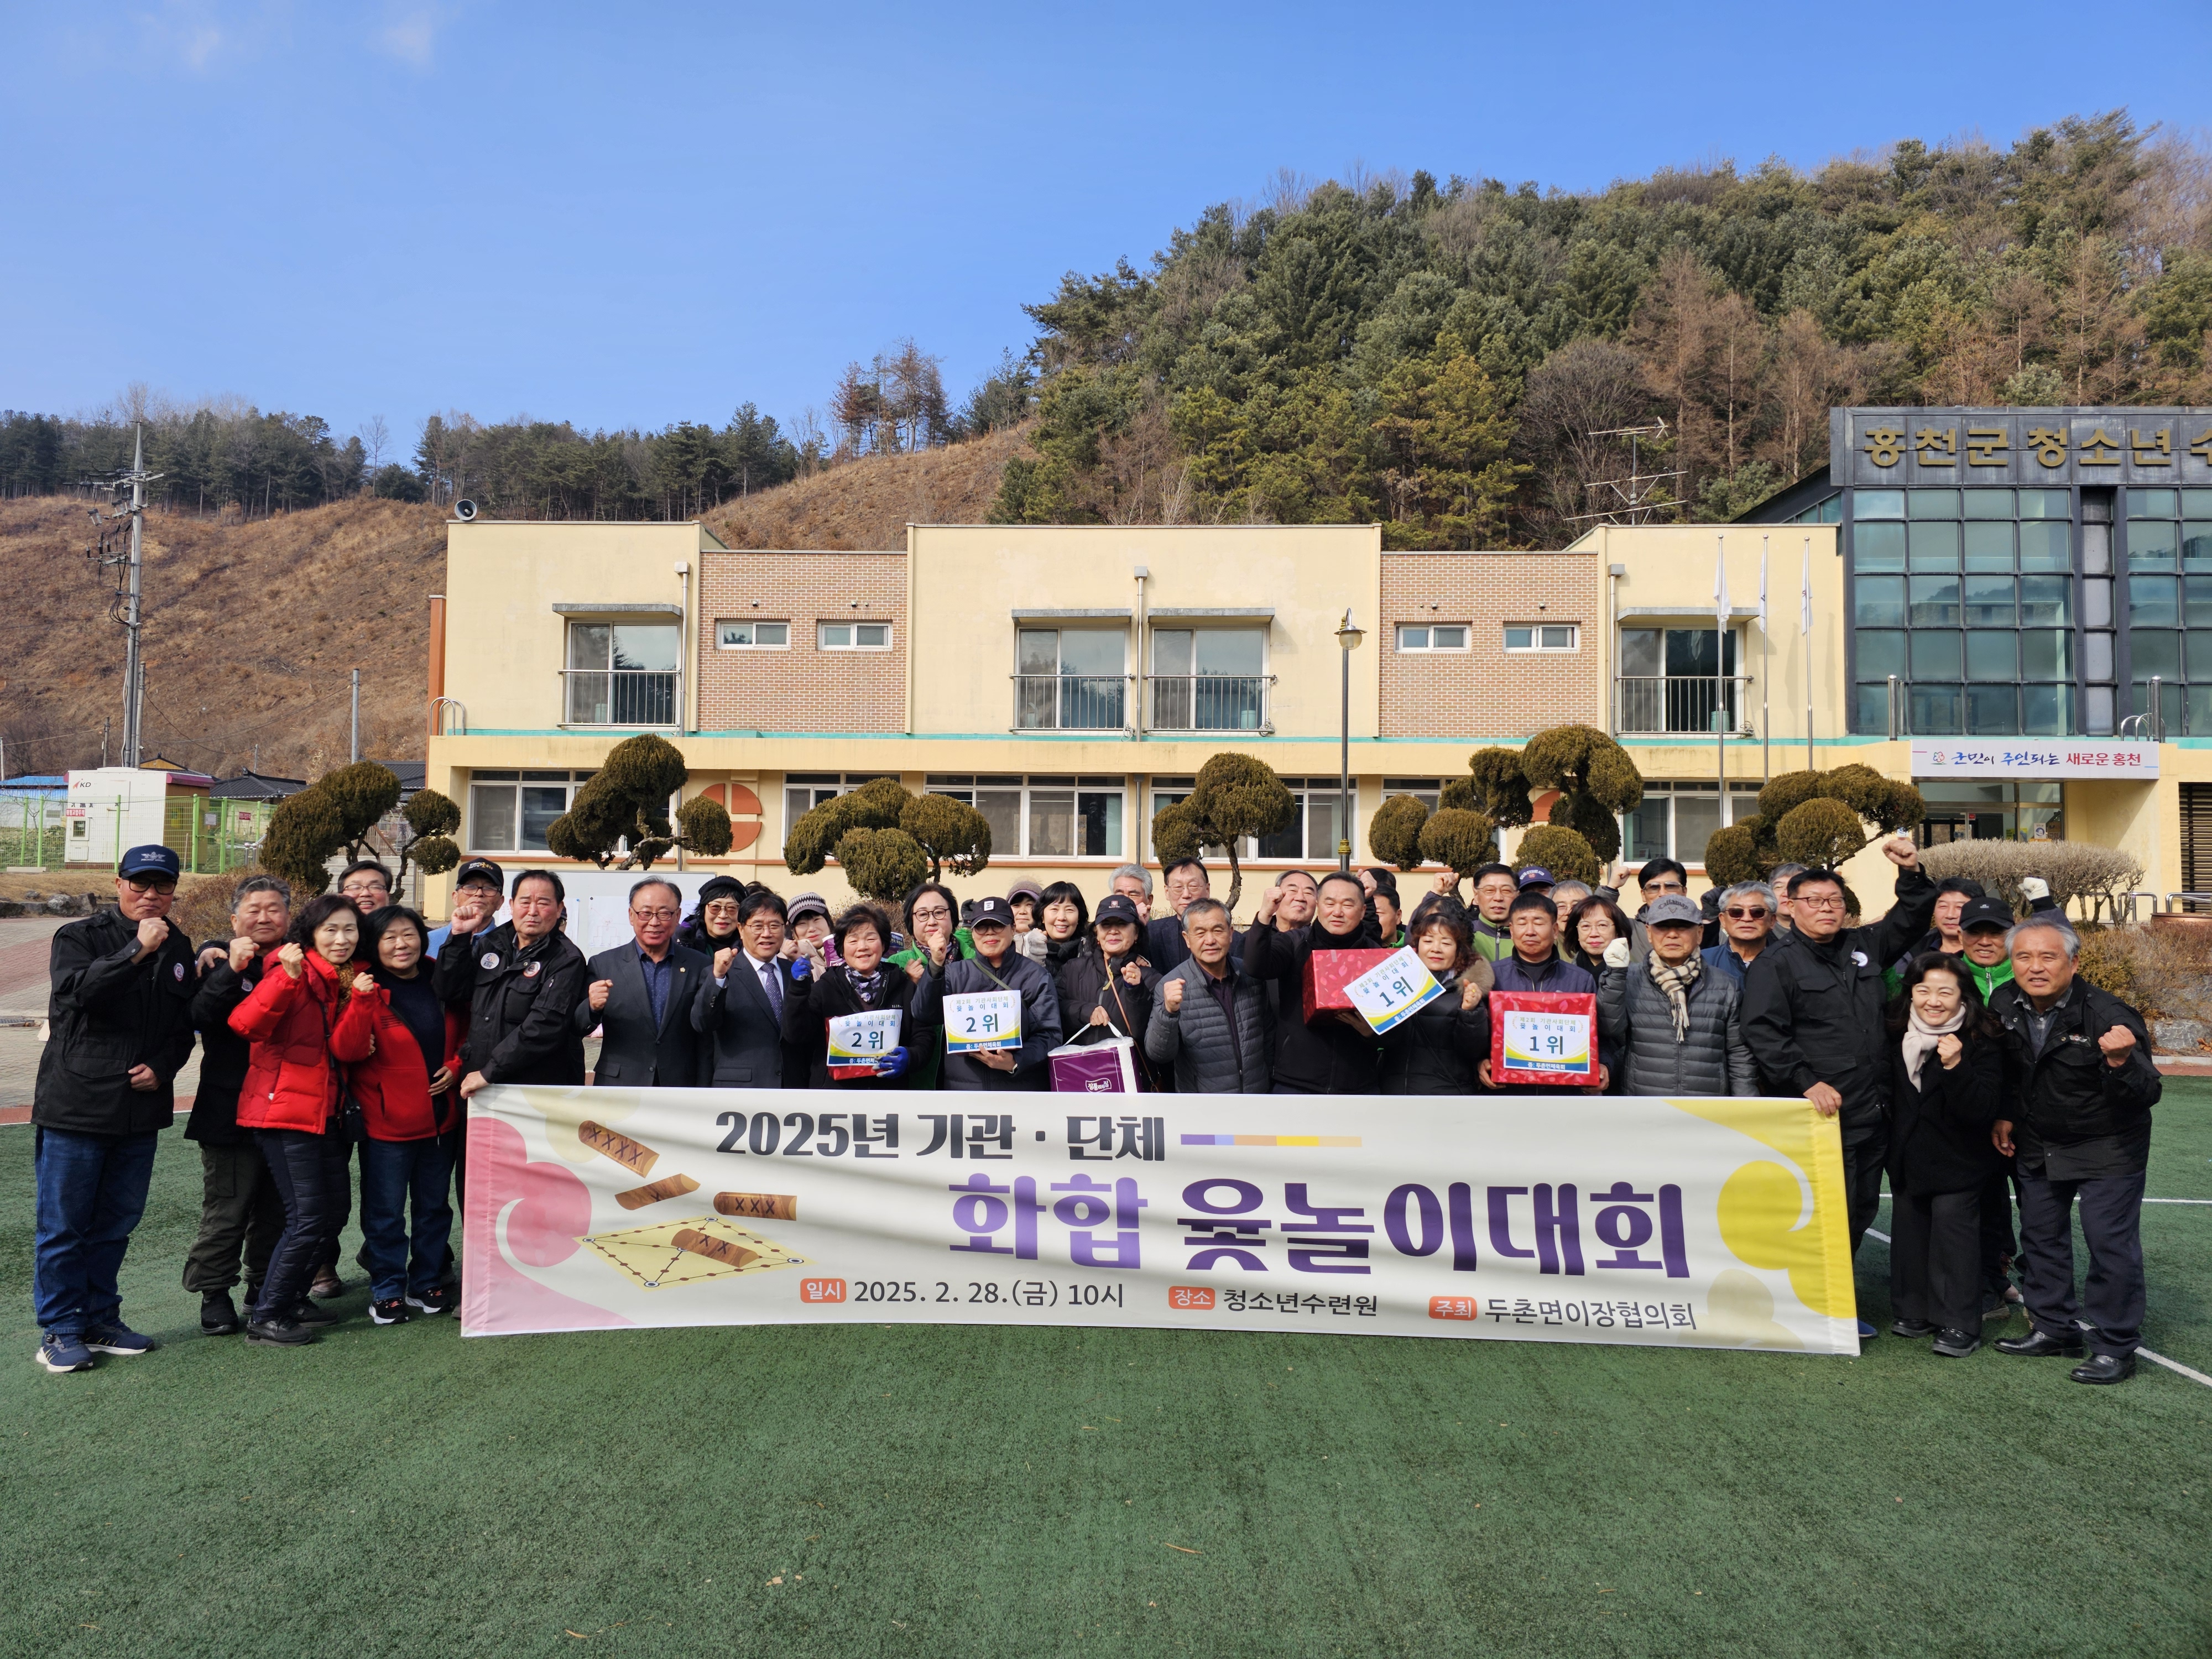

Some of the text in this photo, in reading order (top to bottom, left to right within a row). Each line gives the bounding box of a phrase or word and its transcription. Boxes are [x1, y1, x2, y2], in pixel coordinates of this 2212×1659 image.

[1864, 427, 2009, 467] 홍천군
[1950, 750, 2141, 766] 군민이 주인되는 새로운 홍천
[1658, 899, 1689, 910] Callaway
[1359, 977, 1374, 988] 제2회
[715, 1111, 899, 1159] 2025년
[915, 1114, 1016, 1160] 기관
[1066, 1115, 1165, 1162] 단체
[948, 1172, 1691, 1279] 화합 윷놀이대회
[806, 1281, 841, 1301] 일시
[854, 1281, 926, 1303] 2025.
[935, 1281, 959, 1303] 2.
[1068, 1283, 1124, 1308] 10시
[1174, 1288, 1377, 1317] 장소 청소년수련원
[1434, 1298, 1697, 1330] 주최 두촌면이장협의회
